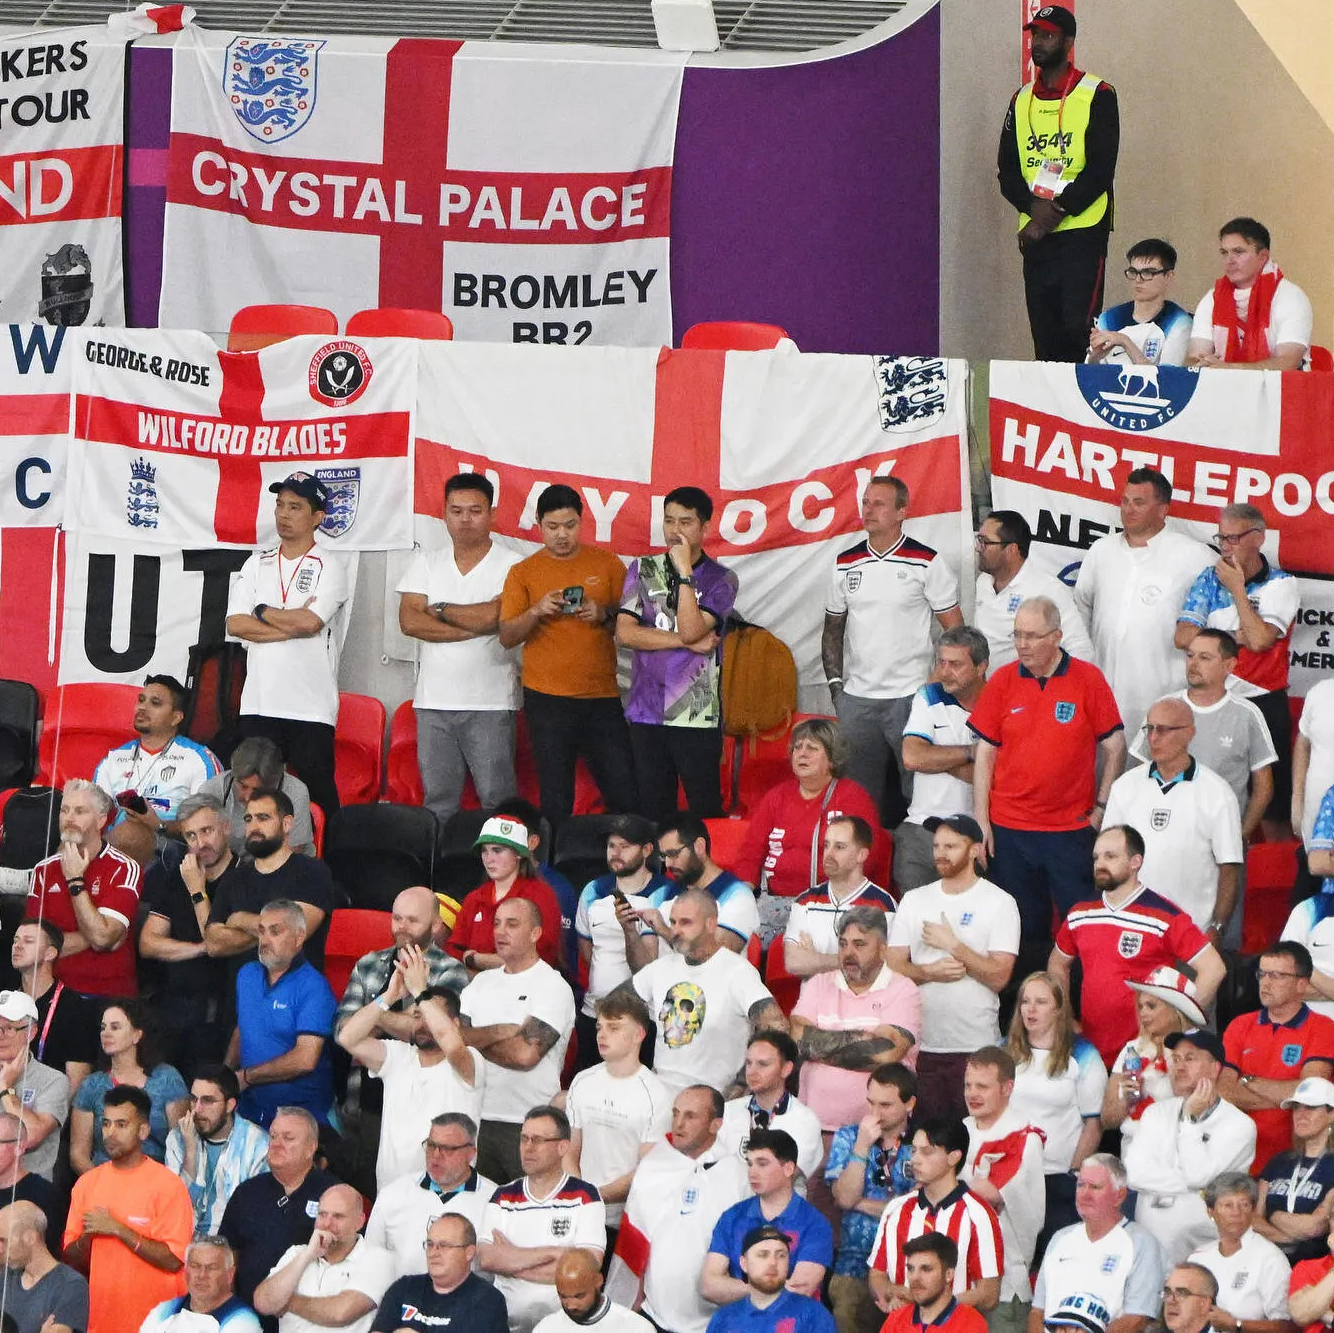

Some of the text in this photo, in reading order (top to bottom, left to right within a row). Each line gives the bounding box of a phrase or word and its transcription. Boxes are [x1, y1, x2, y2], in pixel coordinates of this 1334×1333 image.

[192, 150, 648, 231] CRYSTAL PALACE
[453, 268, 658, 310] BROMLEY
[9, 323, 67, 374] W
[86, 340, 148, 373] GEORGE
[165, 359, 210, 387] ROSE
[310, 343, 337, 385] SHEFFIELD
[338, 341, 366, 366] UNITED
[138, 412, 347, 457] WILFORD BLADES
[1092, 397, 1174, 429] UNITED FC
[15, 457, 52, 509] C
[317, 468, 357, 479] ENGLAND
[1316, 631, 1331, 648] &
